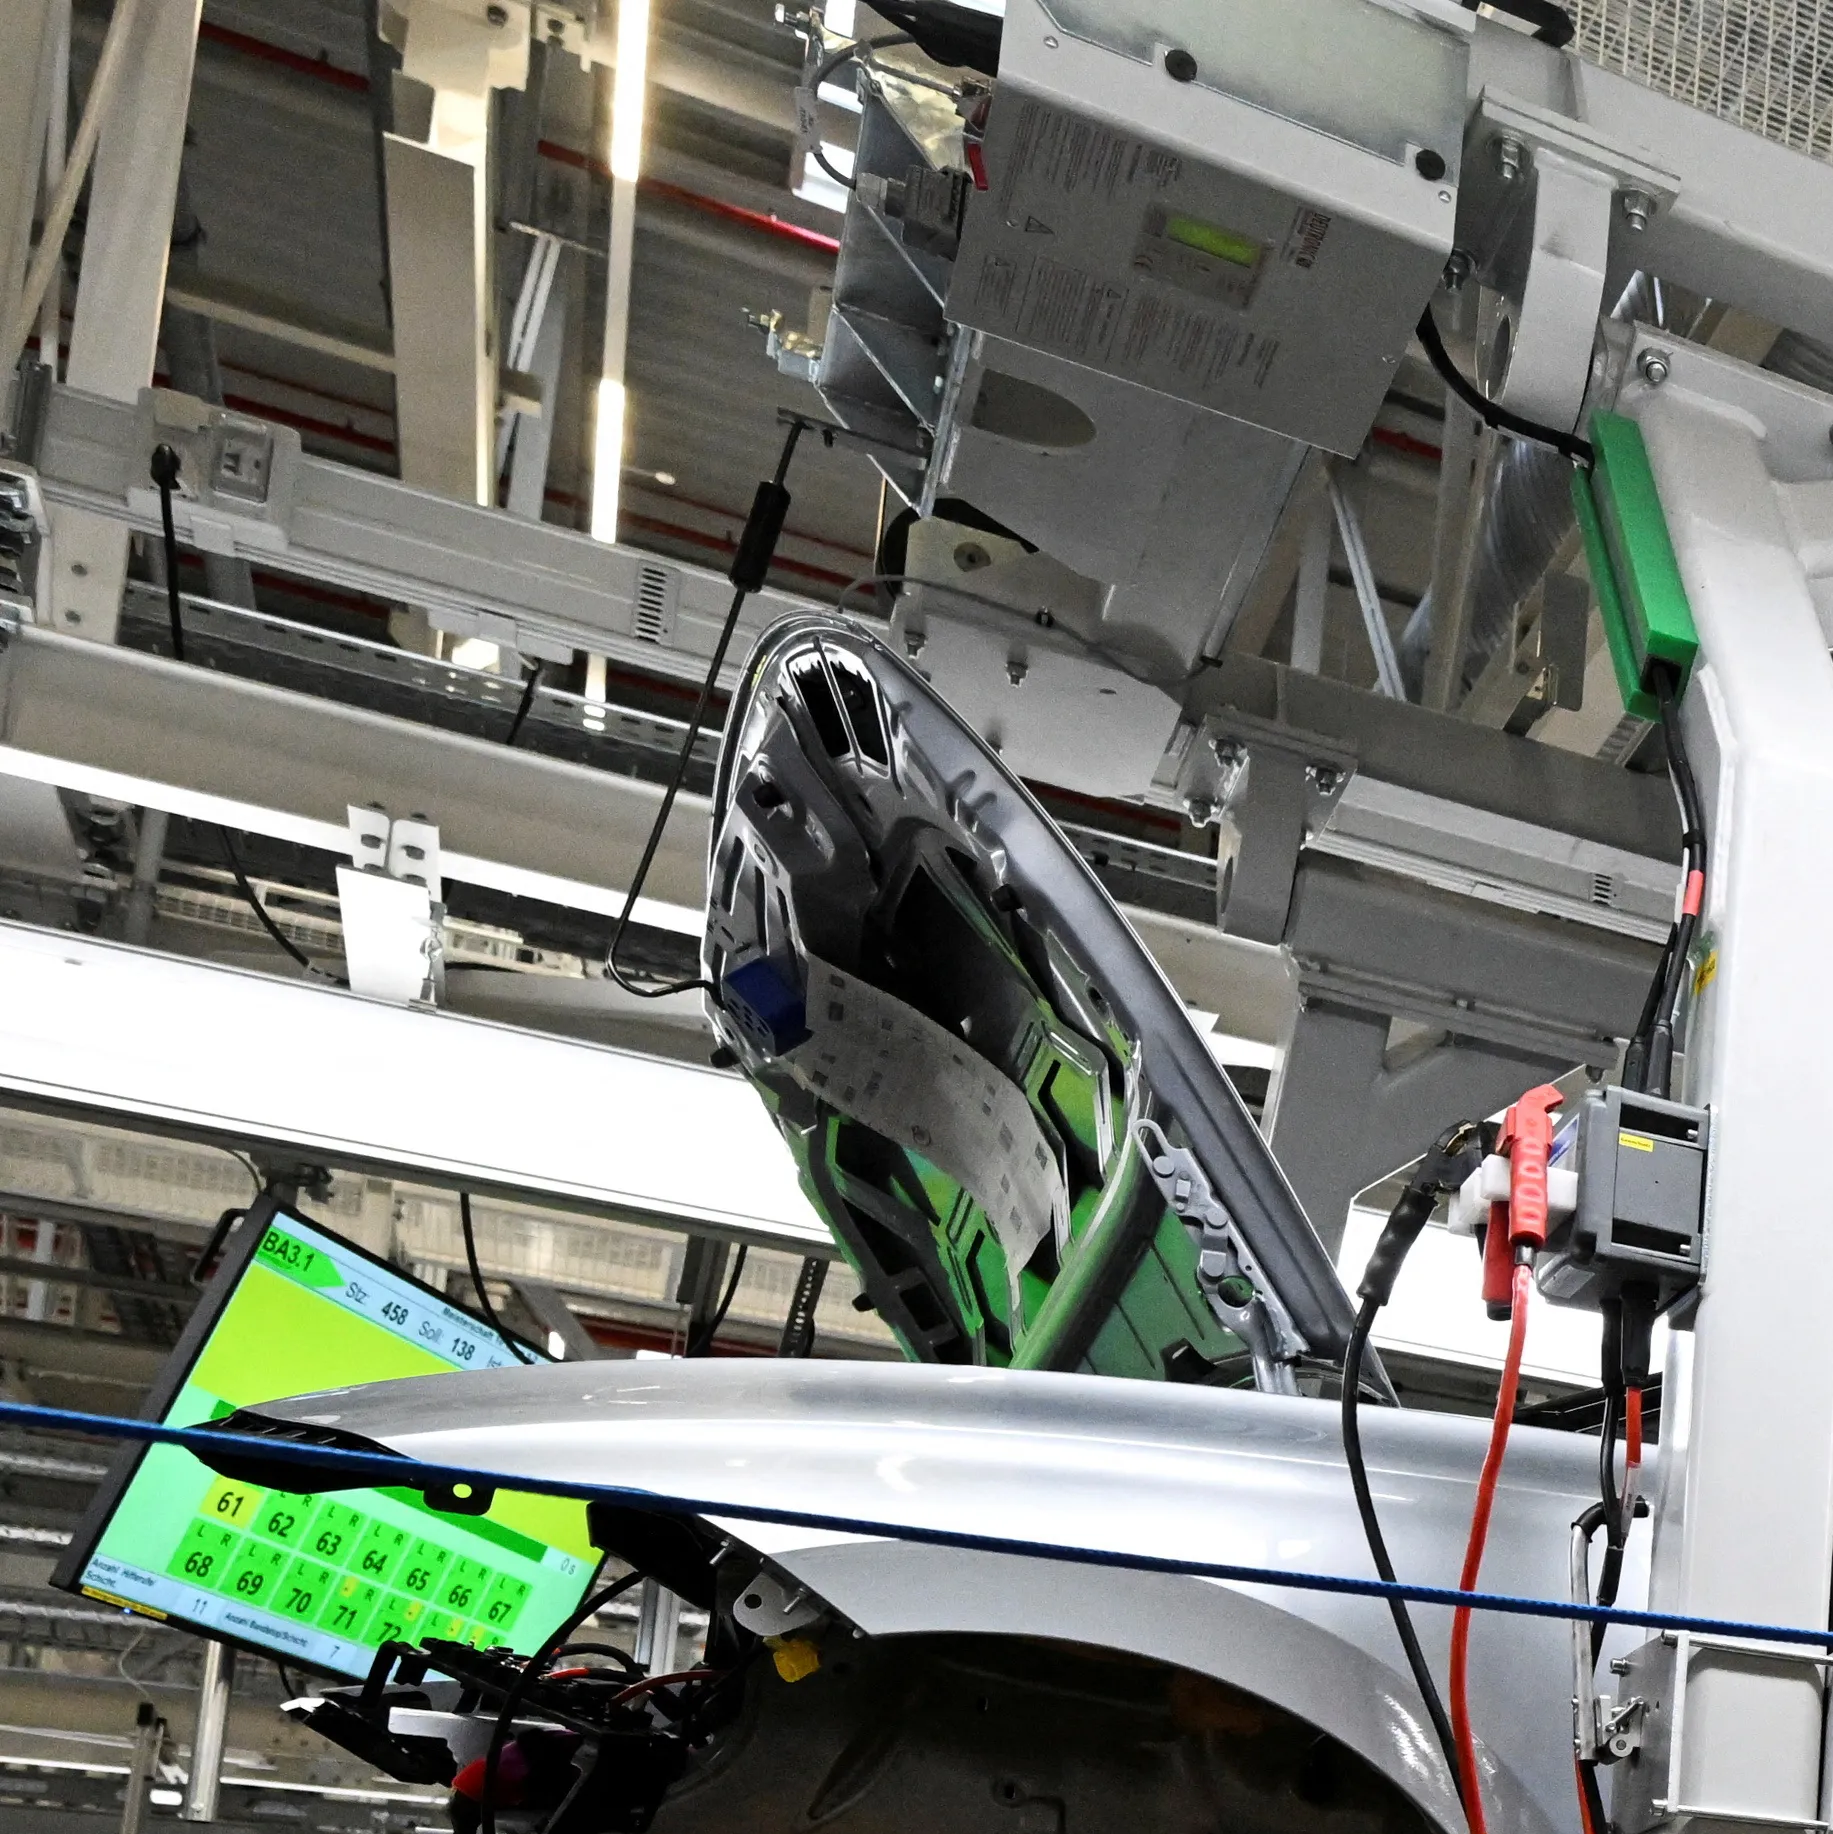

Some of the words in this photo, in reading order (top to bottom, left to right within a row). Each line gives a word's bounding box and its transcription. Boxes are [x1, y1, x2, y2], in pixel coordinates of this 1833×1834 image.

[262, 1231, 316, 1273] BA3.1
[380, 1301, 410, 1326] 458
[450, 1337, 477, 1361] 138
[216, 1491, 245, 1518] 61
[267, 1511, 296, 1539] 62
[315, 1531, 342, 1557] 63
[362, 1549, 388, 1575] 64
[405, 1567, 431, 1592] 65
[448, 1584, 472, 1608] 66
[488, 1600, 512, 1624] 67
[183, 1551, 215, 1578] 68
[236, 1570, 264, 1596] 69
[285, 1587, 313, 1614] 70
[332, 1605, 359, 1631] 71
[191, 1598, 209, 1616] 11
[328, 1644, 340, 1659] 7
